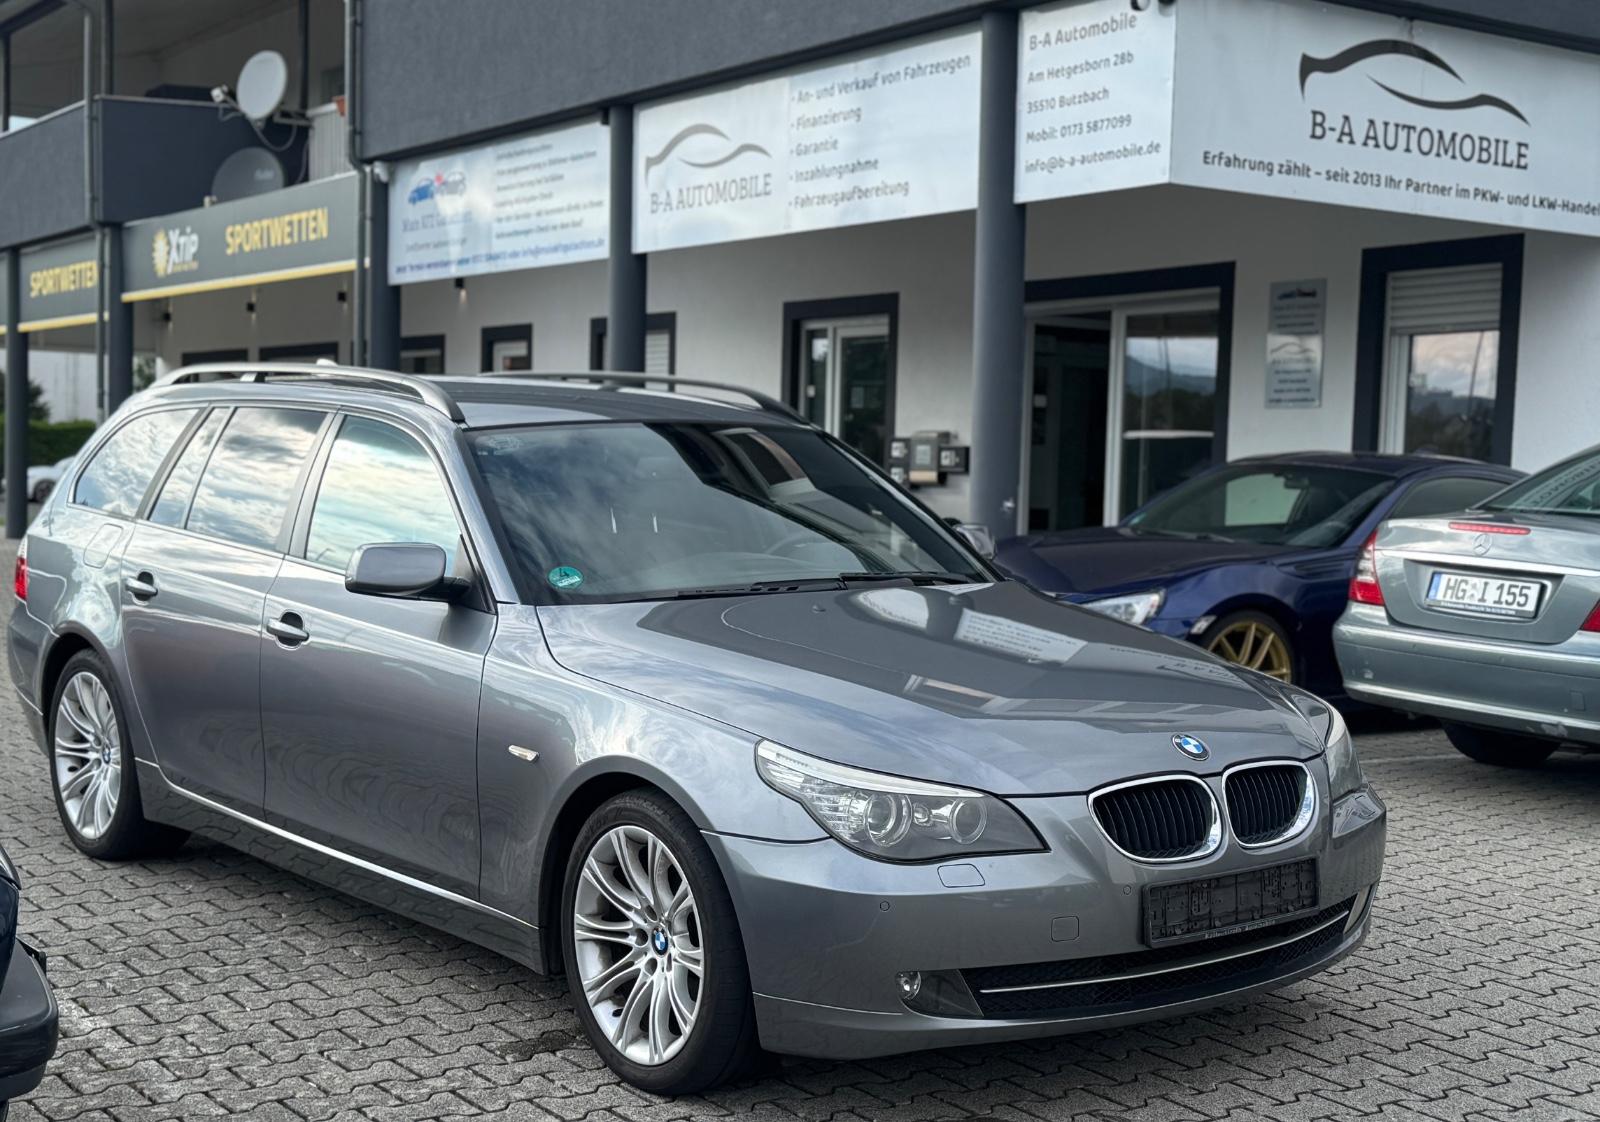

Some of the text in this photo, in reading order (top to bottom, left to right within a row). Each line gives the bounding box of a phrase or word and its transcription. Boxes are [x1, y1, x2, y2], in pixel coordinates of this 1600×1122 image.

[1028, 12, 1137, 51] B-A Automobile
[797, 54, 971, 103] An- und Verkauf von Fahrzeugen
[1027, 50, 1134, 84] Am Hetgesborn 28b
[1026, 87, 1110, 115] 35510 Butzbach
[796, 107, 862, 131] Finanzierung
[1026, 113, 1132, 144] Mobil: 0173 5877099
[795, 136, 838, 156] Garantie
[1024, 139, 1162, 174] info@b-a-automobile.de
[1309, 109, 1530, 171] B-A AUTOMOBILE
[650, 172, 772, 214] B-A AUTOMOBILE
[794, 180, 909, 208] Fahrzeugaufbereitung
[1203, 150, 1274, 177] Erfahrung
[1277, 159, 1312, 178] zählt
[1325, 167, 1350, 183] seit
[1352, 170, 1381, 187] 2013
[1384, 175, 1402, 190] Ihr
[1405, 178, 1453, 197] Partner
[1455, 183, 1470, 199] im
[1473, 187, 1505, 204] PKW-
[1507, 193, 1530, 208] und
[225, 206, 329, 256] SPORTWETTEN
[1443, 576, 1470, 601] HG
[1493, 582, 1531, 609] 155
